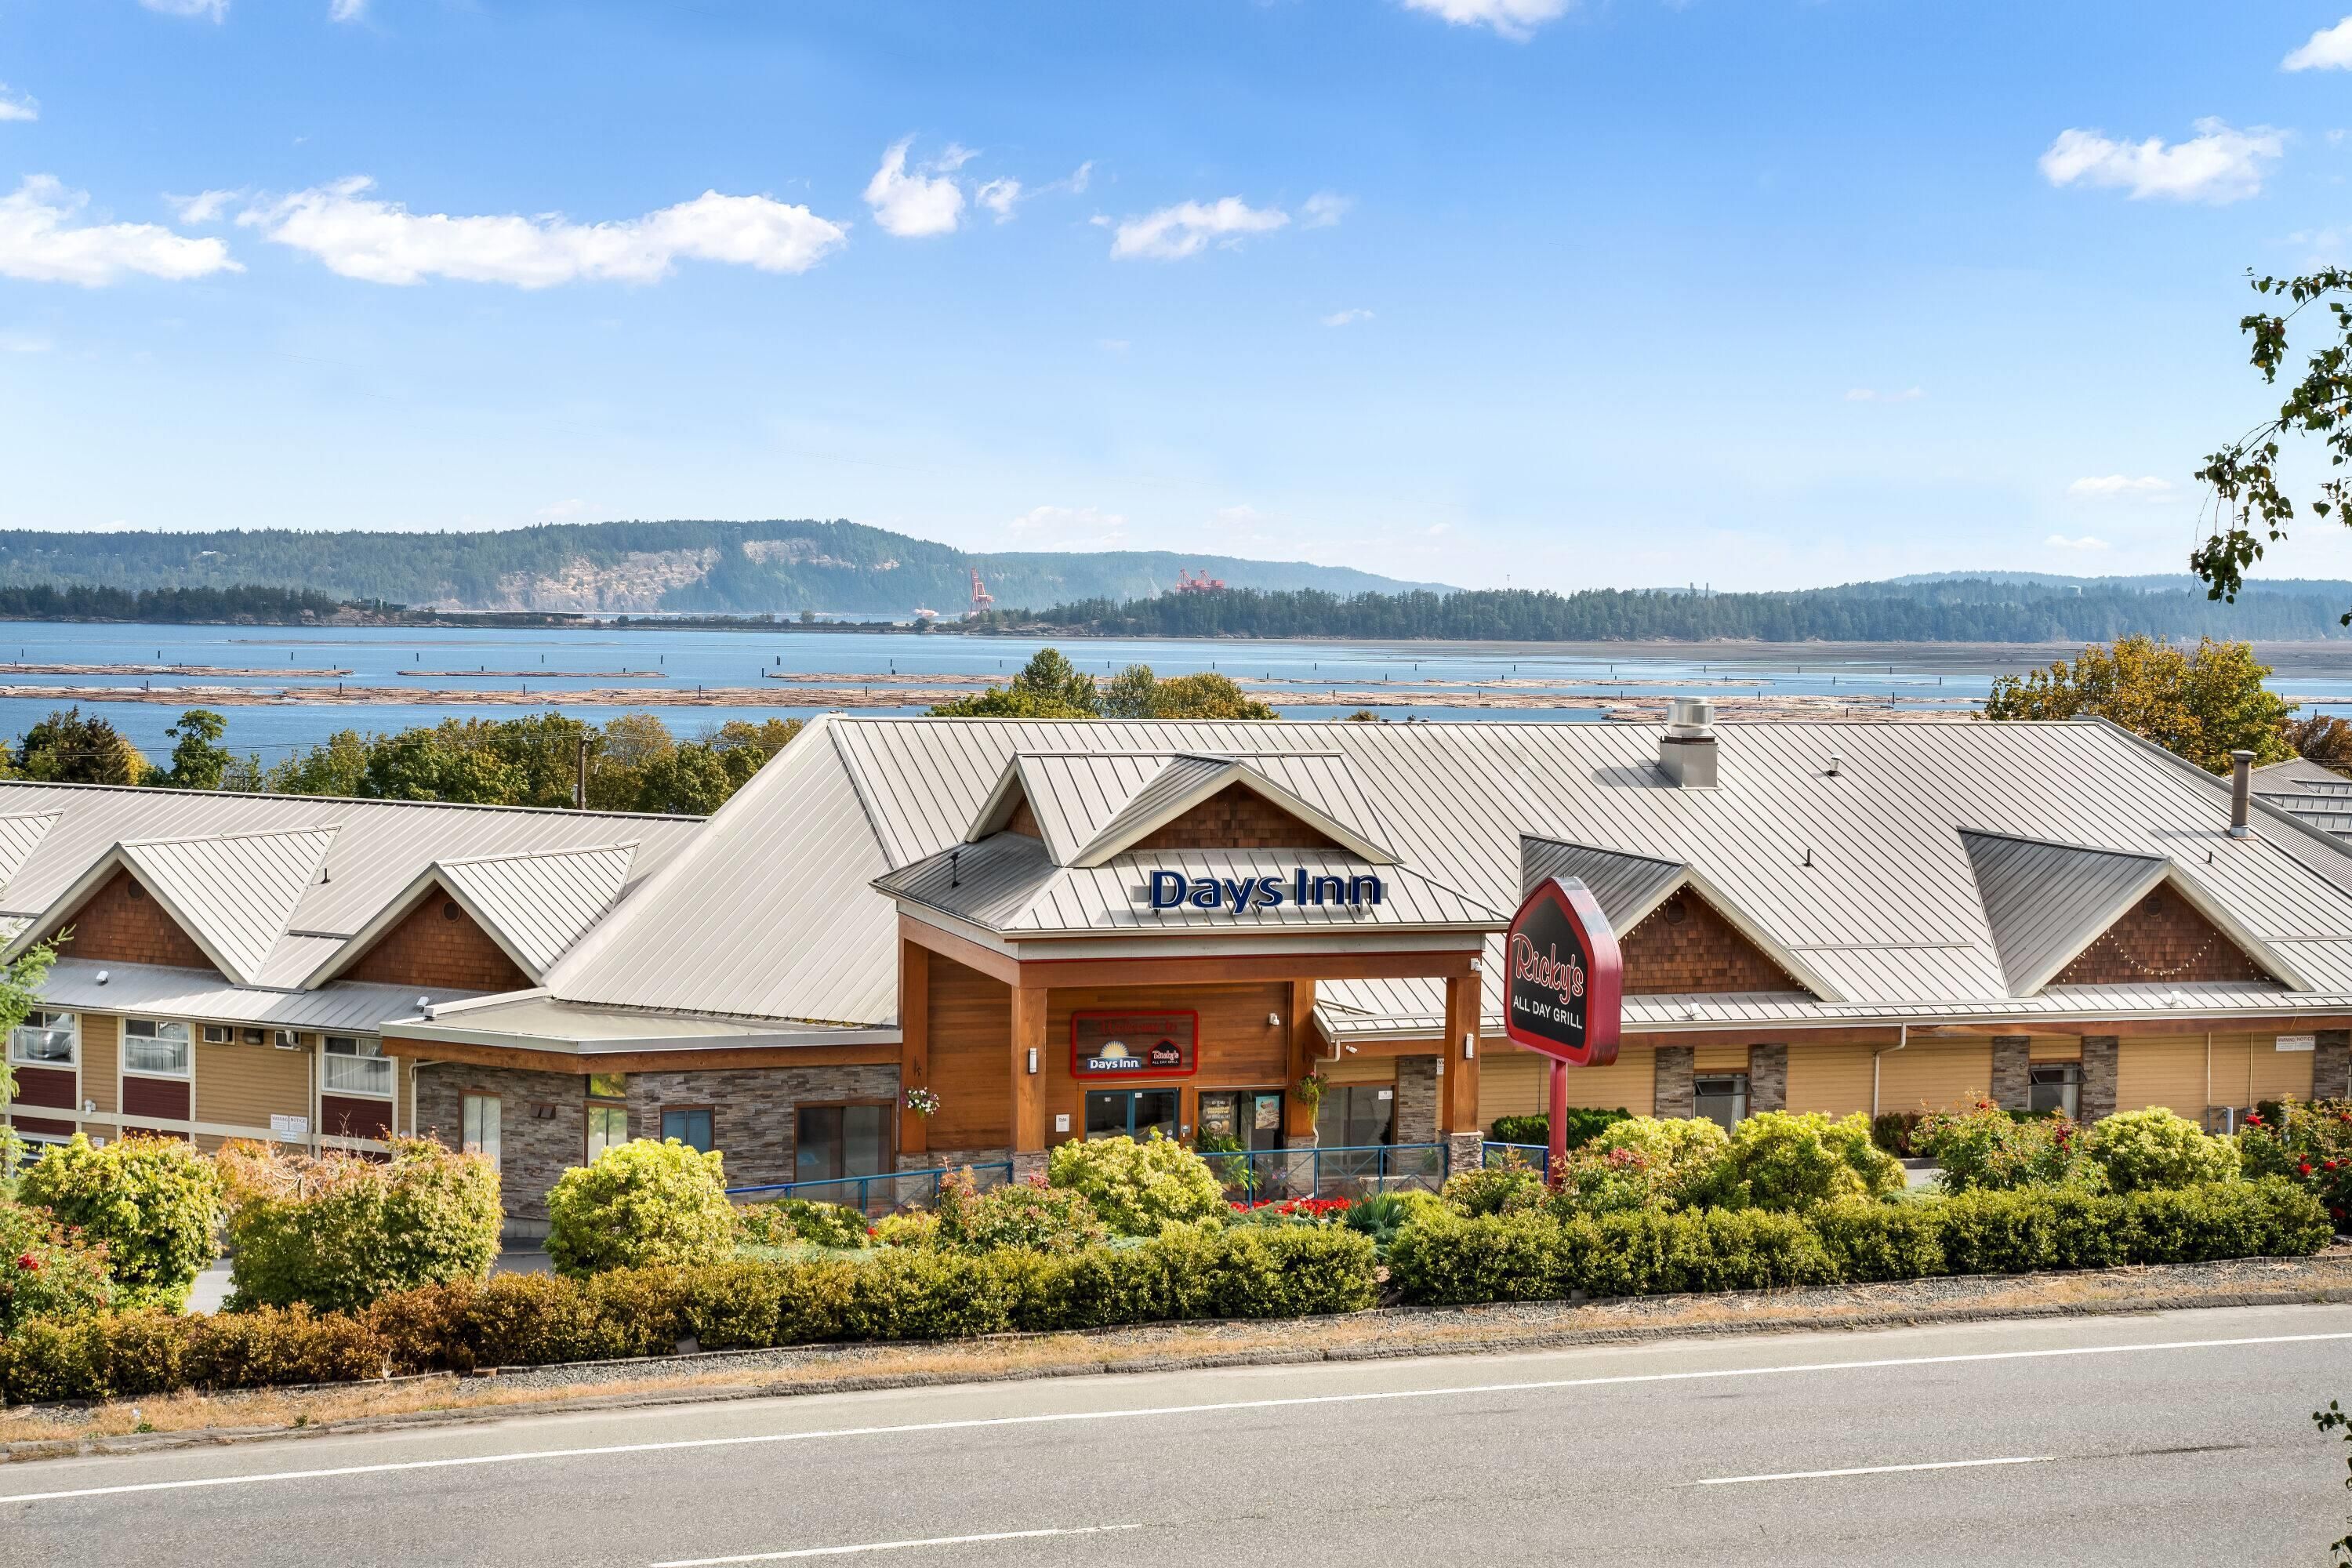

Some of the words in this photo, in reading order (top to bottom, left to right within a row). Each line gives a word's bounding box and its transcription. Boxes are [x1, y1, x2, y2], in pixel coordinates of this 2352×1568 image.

[1149, 869, 1285, 916] Days
[1294, 867, 1382, 906] Inn
[1512, 933, 1584, 1005] Ricky's
[1513, 995, 1530, 1012] ALL
[1533, 1000, 1552, 1018] DAY
[1553, 1007, 1583, 1029] GRILL
[1090, 1059, 1118, 1069] Days
